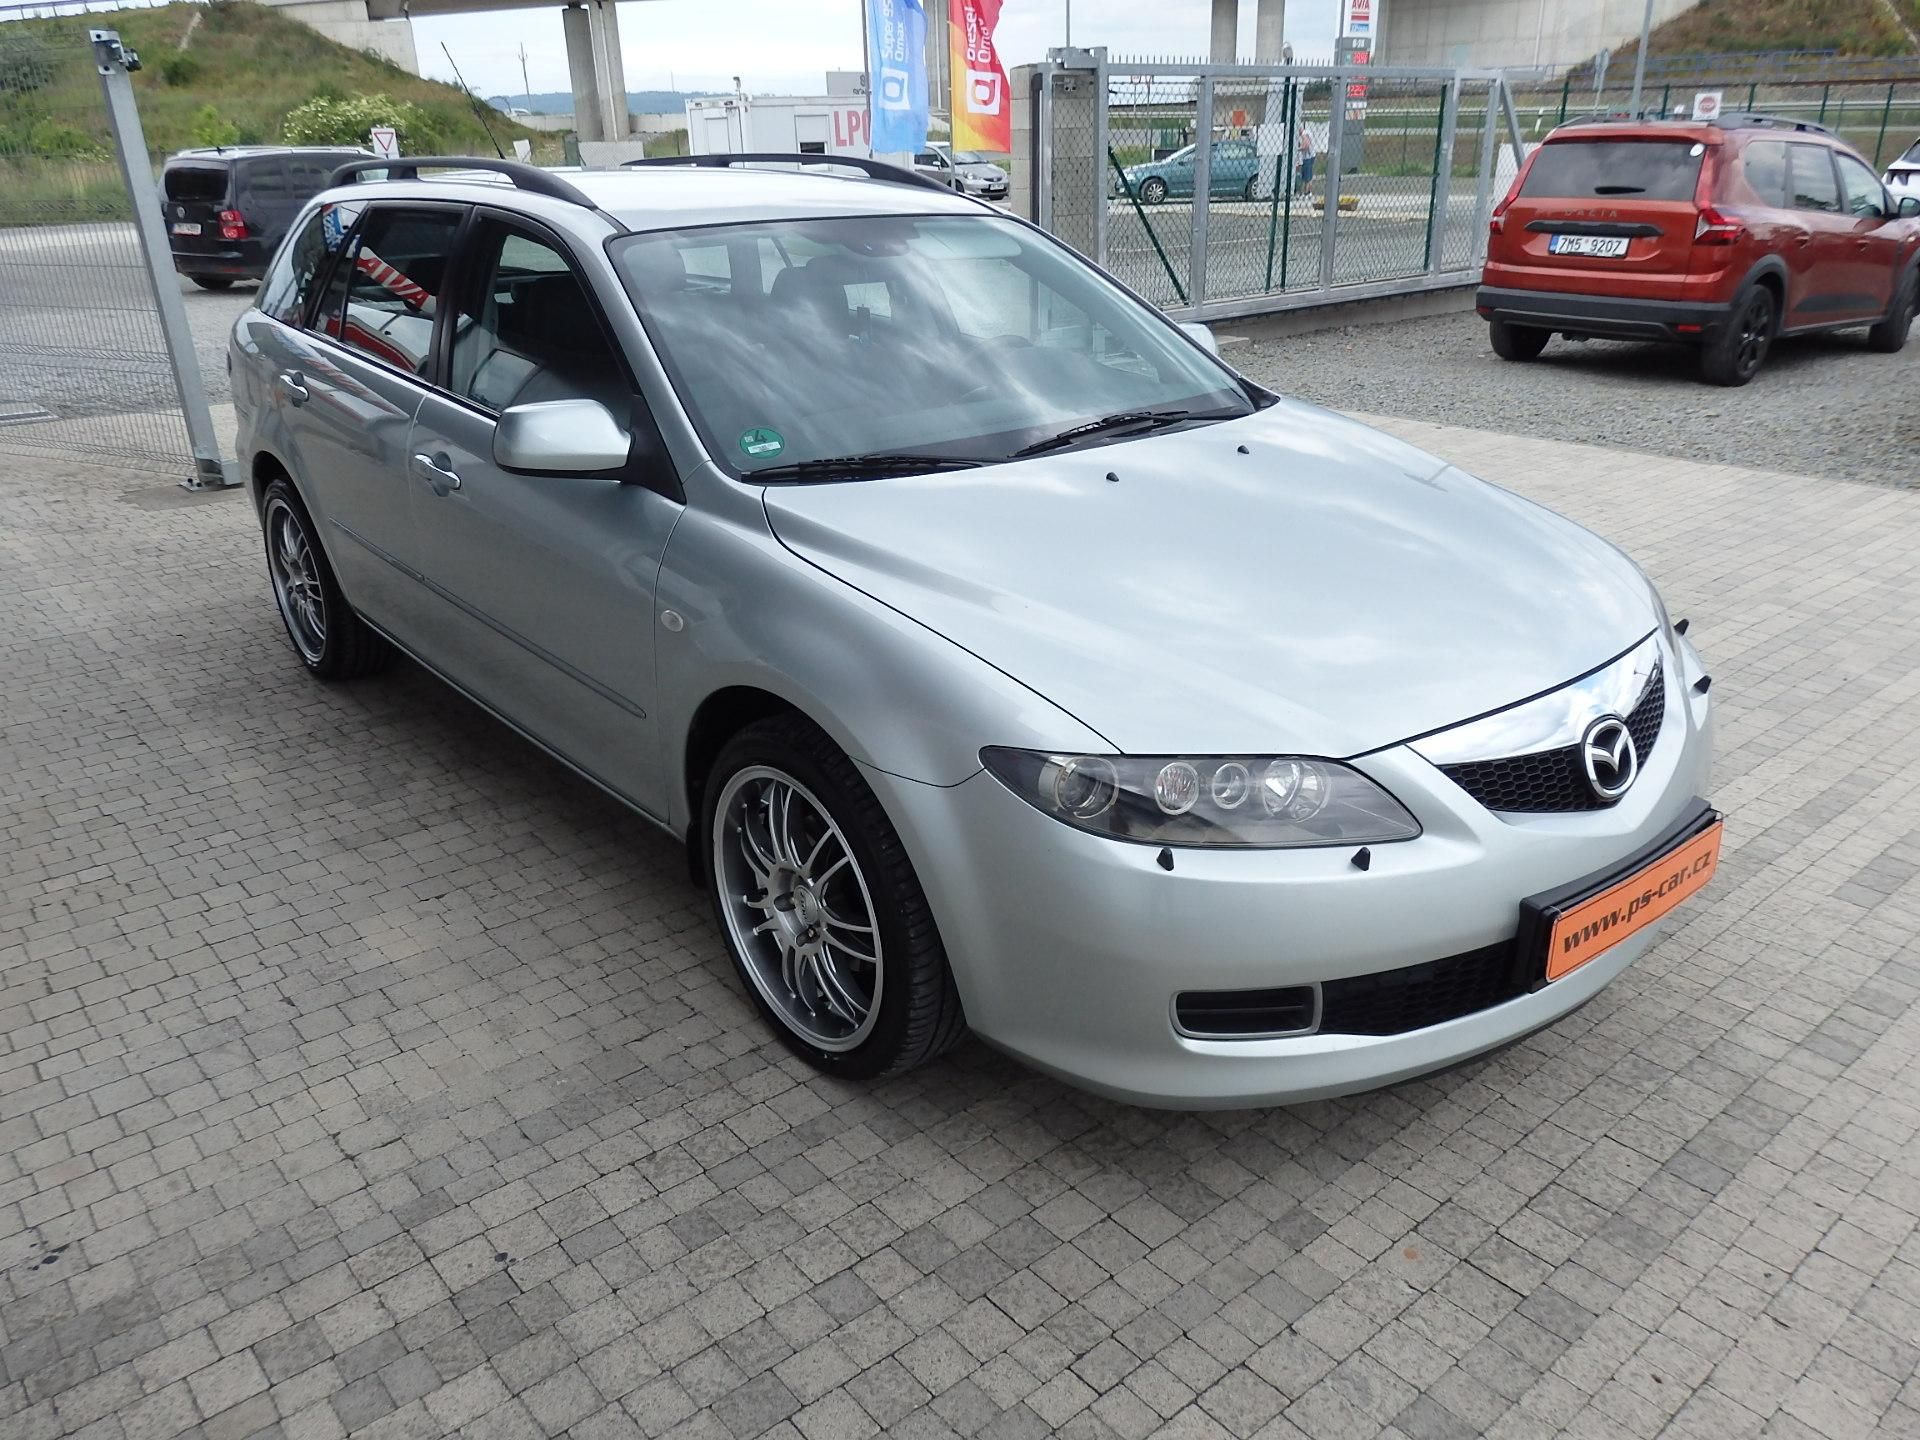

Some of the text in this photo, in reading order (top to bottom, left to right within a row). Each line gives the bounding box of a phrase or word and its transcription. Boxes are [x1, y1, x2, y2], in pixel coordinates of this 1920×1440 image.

[1559, 238, 1622, 254] 7M5 9207
[1564, 850, 1712, 954] www.ps-car.cz
